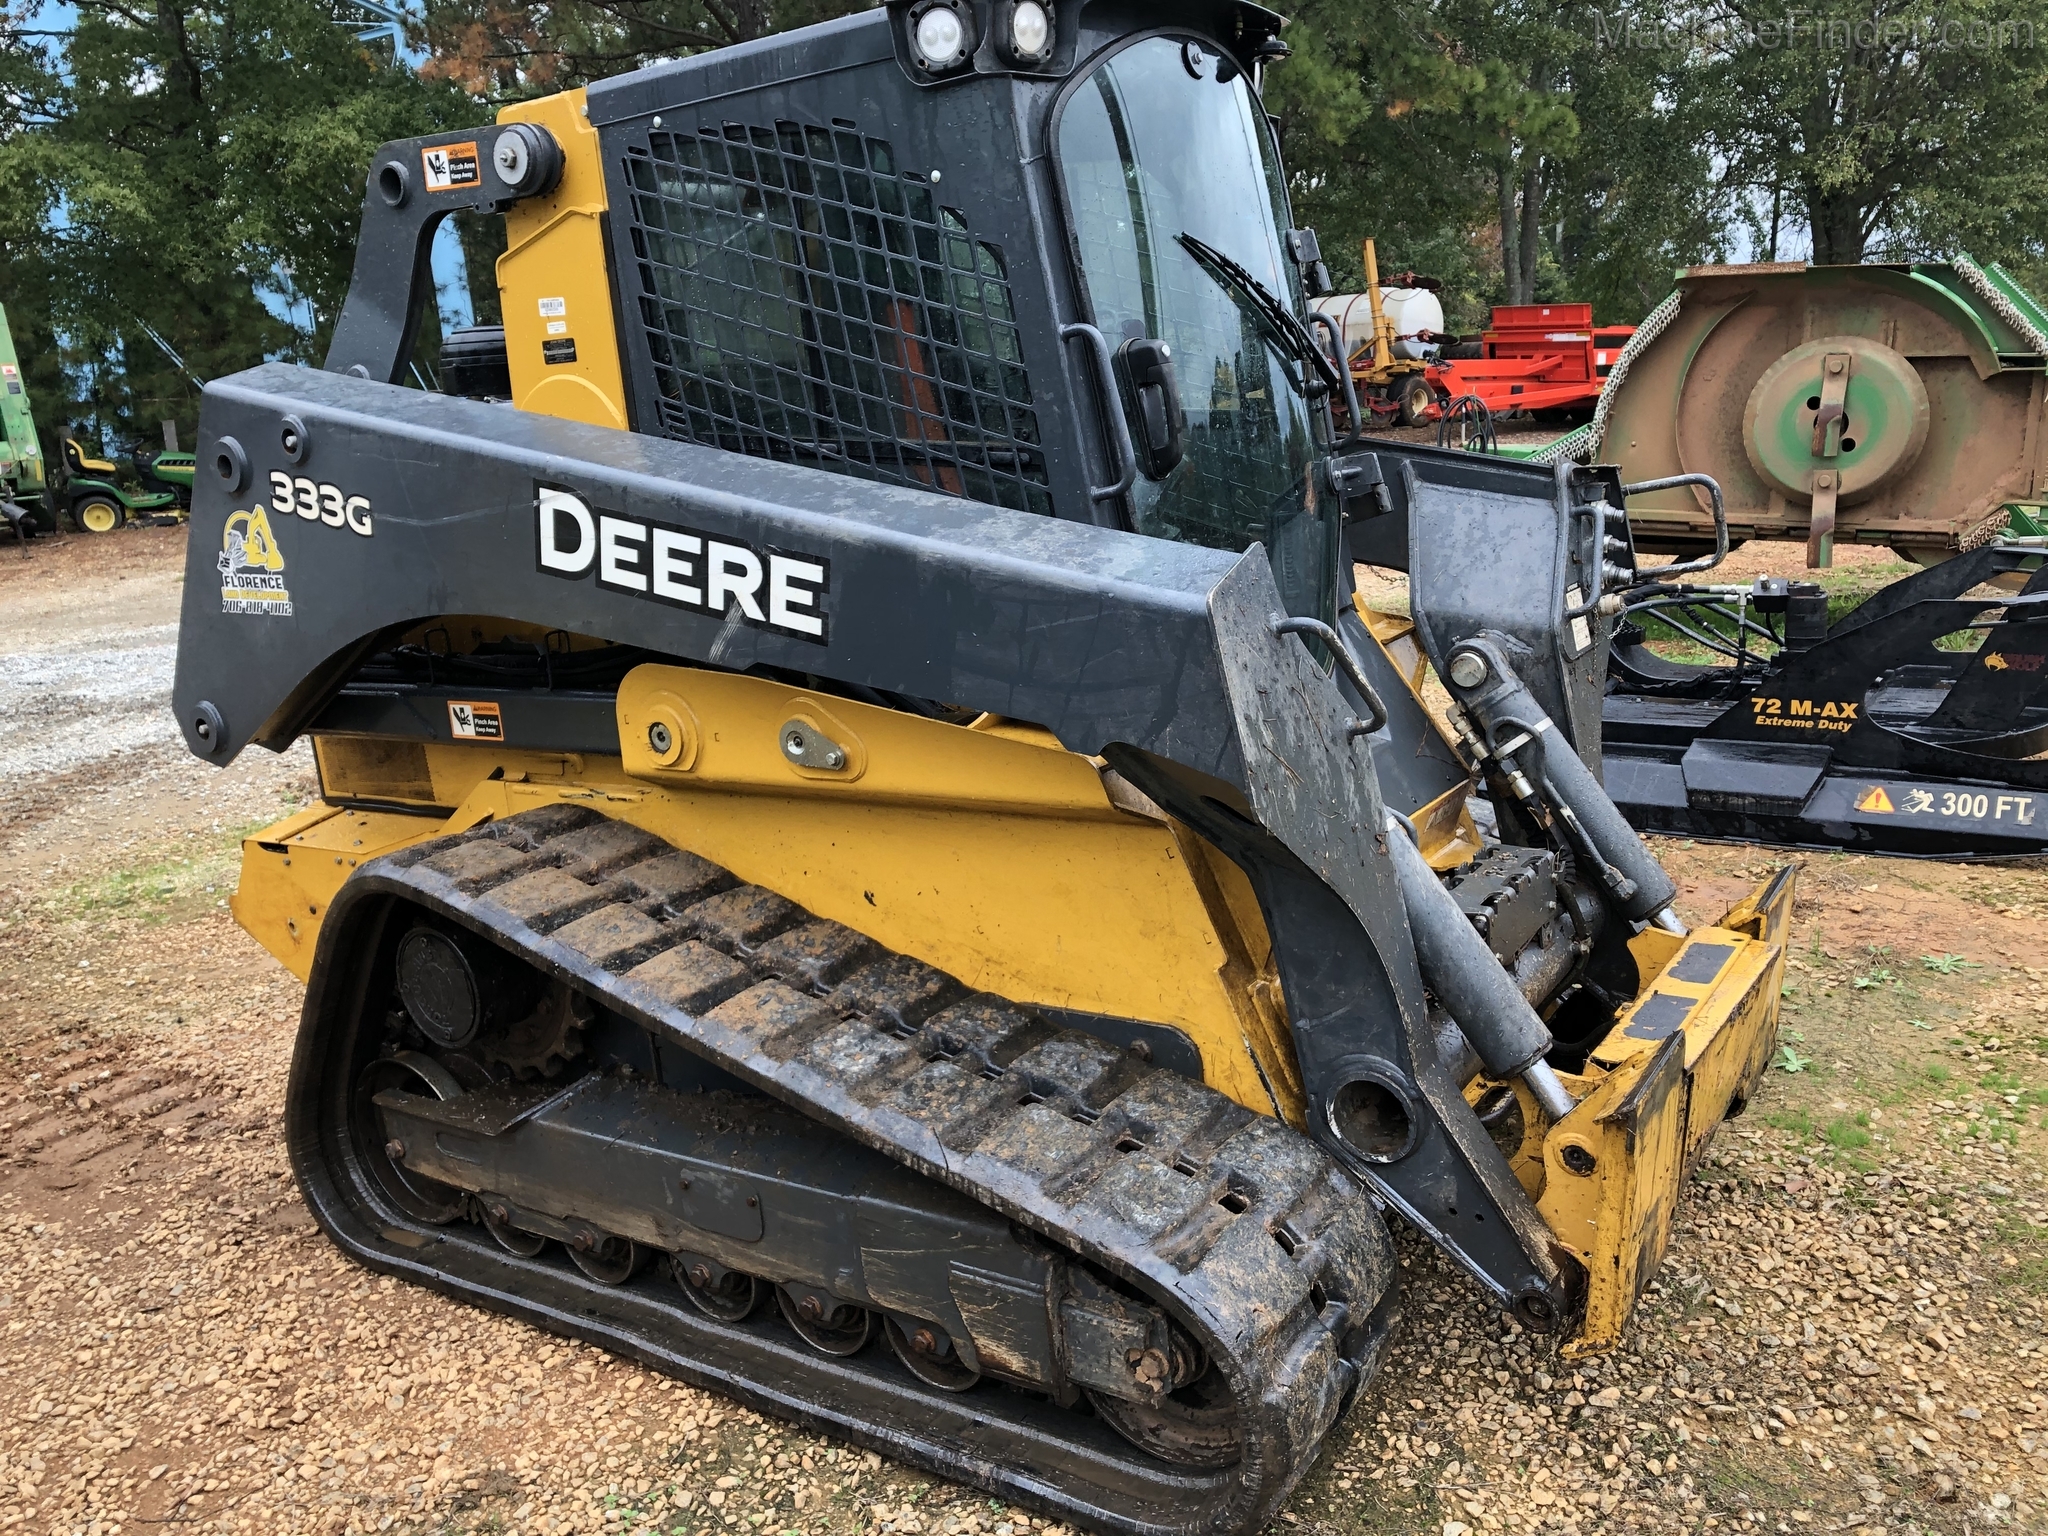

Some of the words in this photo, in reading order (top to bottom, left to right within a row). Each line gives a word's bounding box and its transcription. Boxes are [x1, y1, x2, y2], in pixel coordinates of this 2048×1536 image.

[450, 163, 463, 171] Pinch
[270, 471, 372, 536] 333G
[539, 487, 824, 636] DEERE
[224, 576, 283, 589] FLORENCE
[1751, 697, 1782, 714] 72
[1790, 699, 1859, 719] M-AX
[1755, 715, 1814, 728] Extreme
[1818, 720, 1852, 733] Duty
[1941, 792, 1988, 818] 300
[1995, 795, 2032, 821] FT
